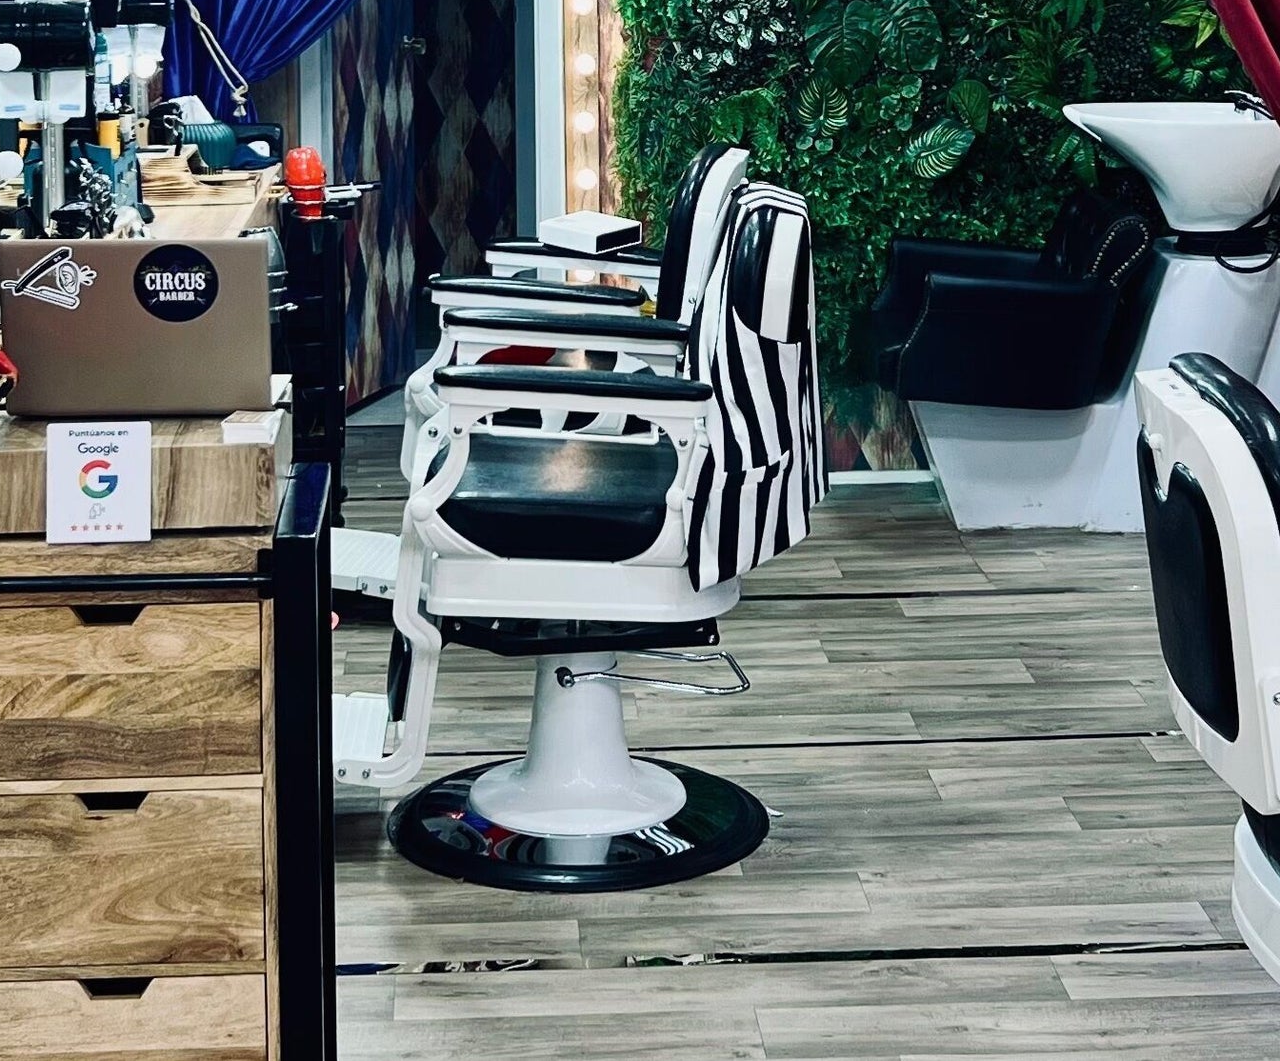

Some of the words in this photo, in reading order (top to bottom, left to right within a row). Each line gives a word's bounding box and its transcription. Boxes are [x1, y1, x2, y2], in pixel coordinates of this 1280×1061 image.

[144, 272, 206, 291] CIRCUS
[159, 291, 195, 302] BARBER
[69, 429, 115, 437] Puntúanos
[78, 443, 119, 456] Google
[79, 459, 119, 499] G
